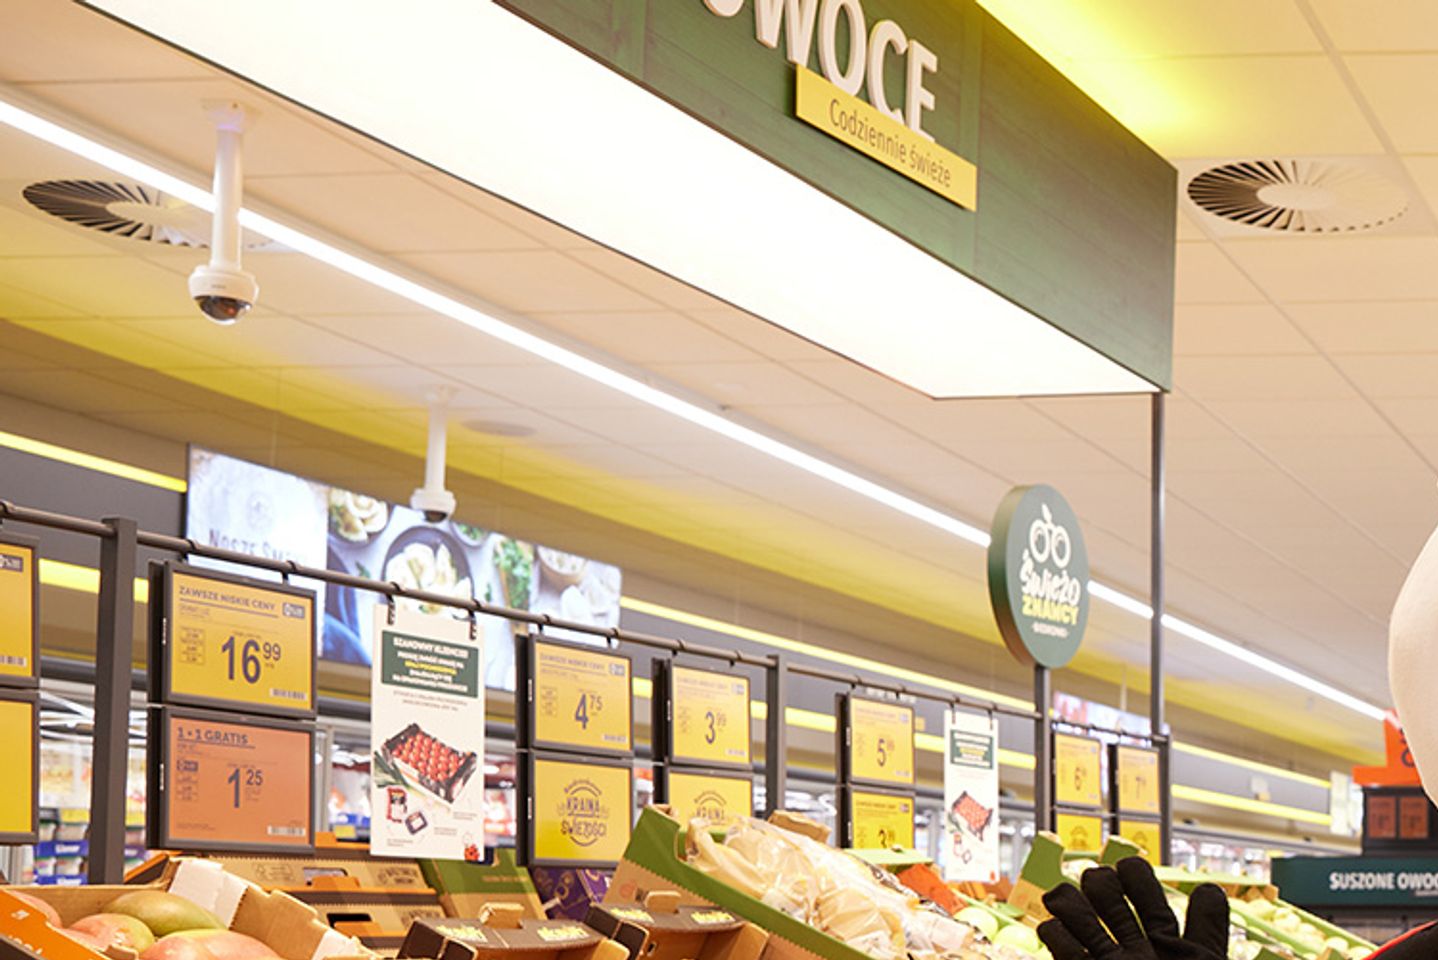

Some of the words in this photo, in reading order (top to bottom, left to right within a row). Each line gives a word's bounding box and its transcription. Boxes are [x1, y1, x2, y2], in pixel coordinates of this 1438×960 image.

[705, 0, 938, 143] WOCE
[828, 98, 906, 165] Codziennie
[909, 142, 951, 189] świeże
[222, 636, 261, 684] 16
[263, 642, 281, 661] 99
[575, 694, 588, 730] 4
[705, 712, 716, 744] 3
[205, 730, 248, 745] GRATIS
[227, 768, 240, 808] 1
[246, 769, 262, 786] 25
[1329, 872, 1394, 890] SUSZONE
